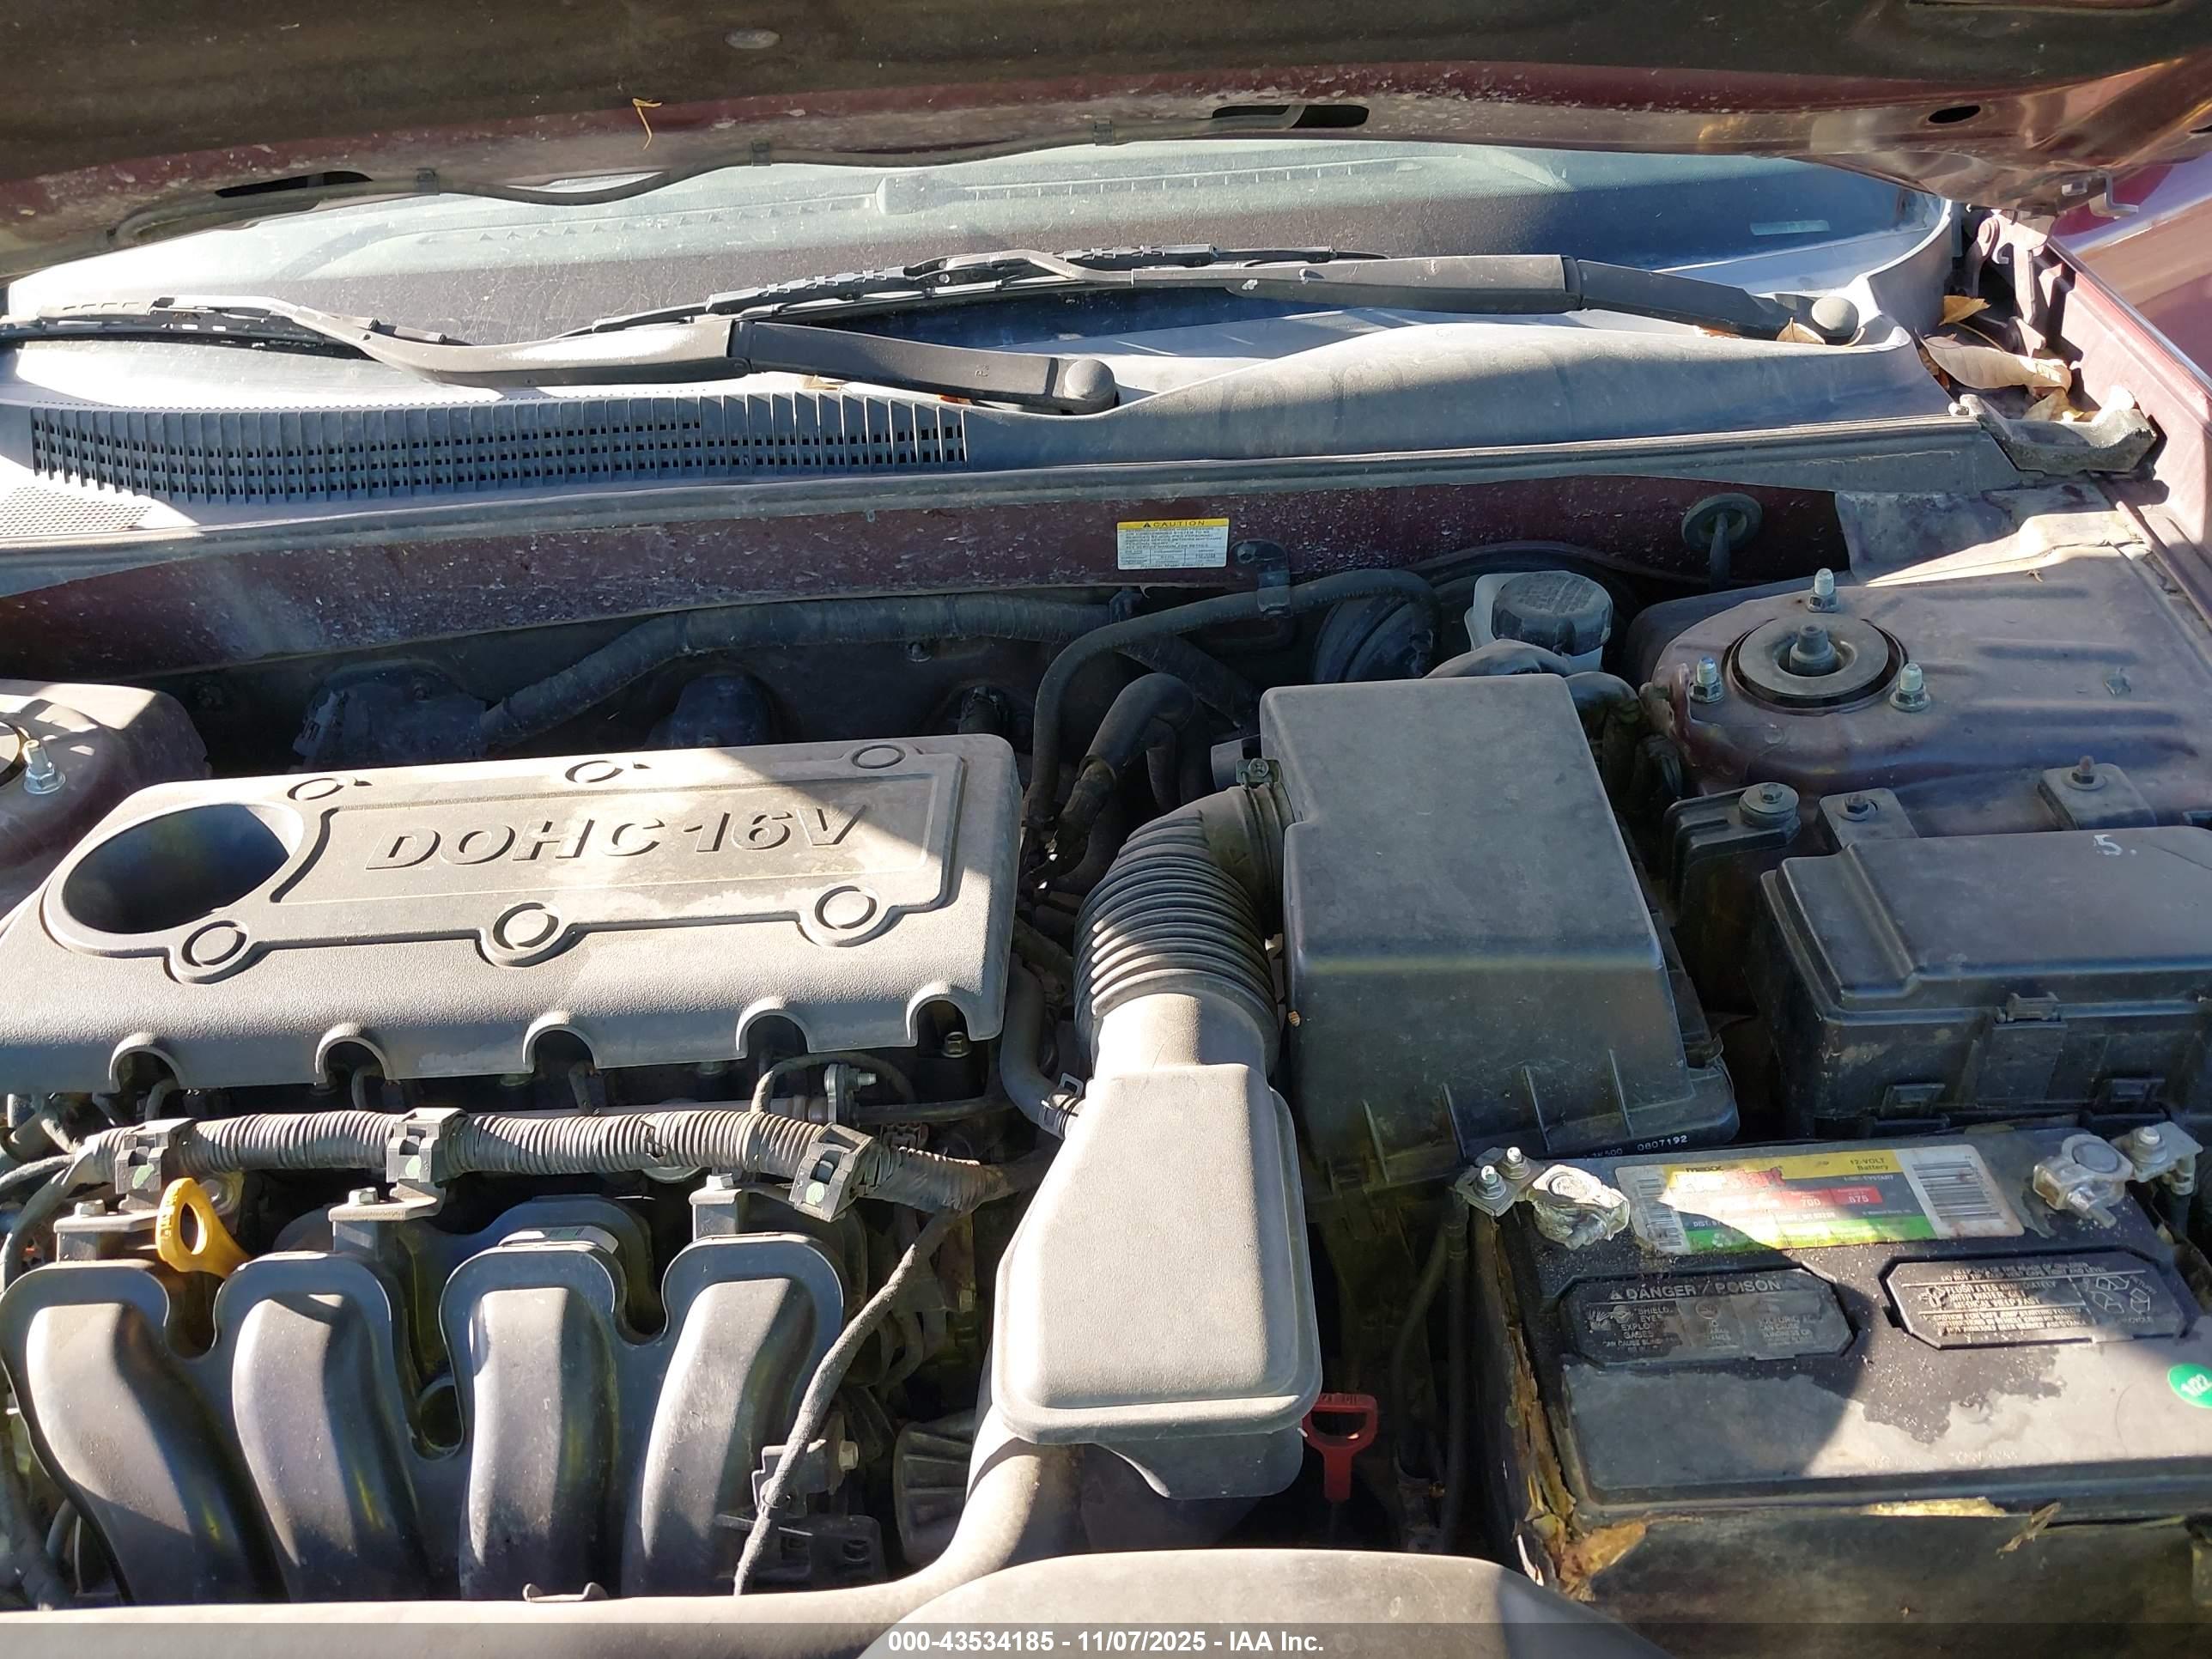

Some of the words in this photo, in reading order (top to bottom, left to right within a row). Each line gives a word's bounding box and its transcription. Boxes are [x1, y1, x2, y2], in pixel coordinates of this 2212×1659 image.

[366, 817, 666, 871] DOHC
[684, 804, 866, 854] 16V
[1801, 1198, 1821, 1207] 700
[1626, 1285, 1697, 1300] DANGER
[1714, 1279, 1782, 1295] POISON
